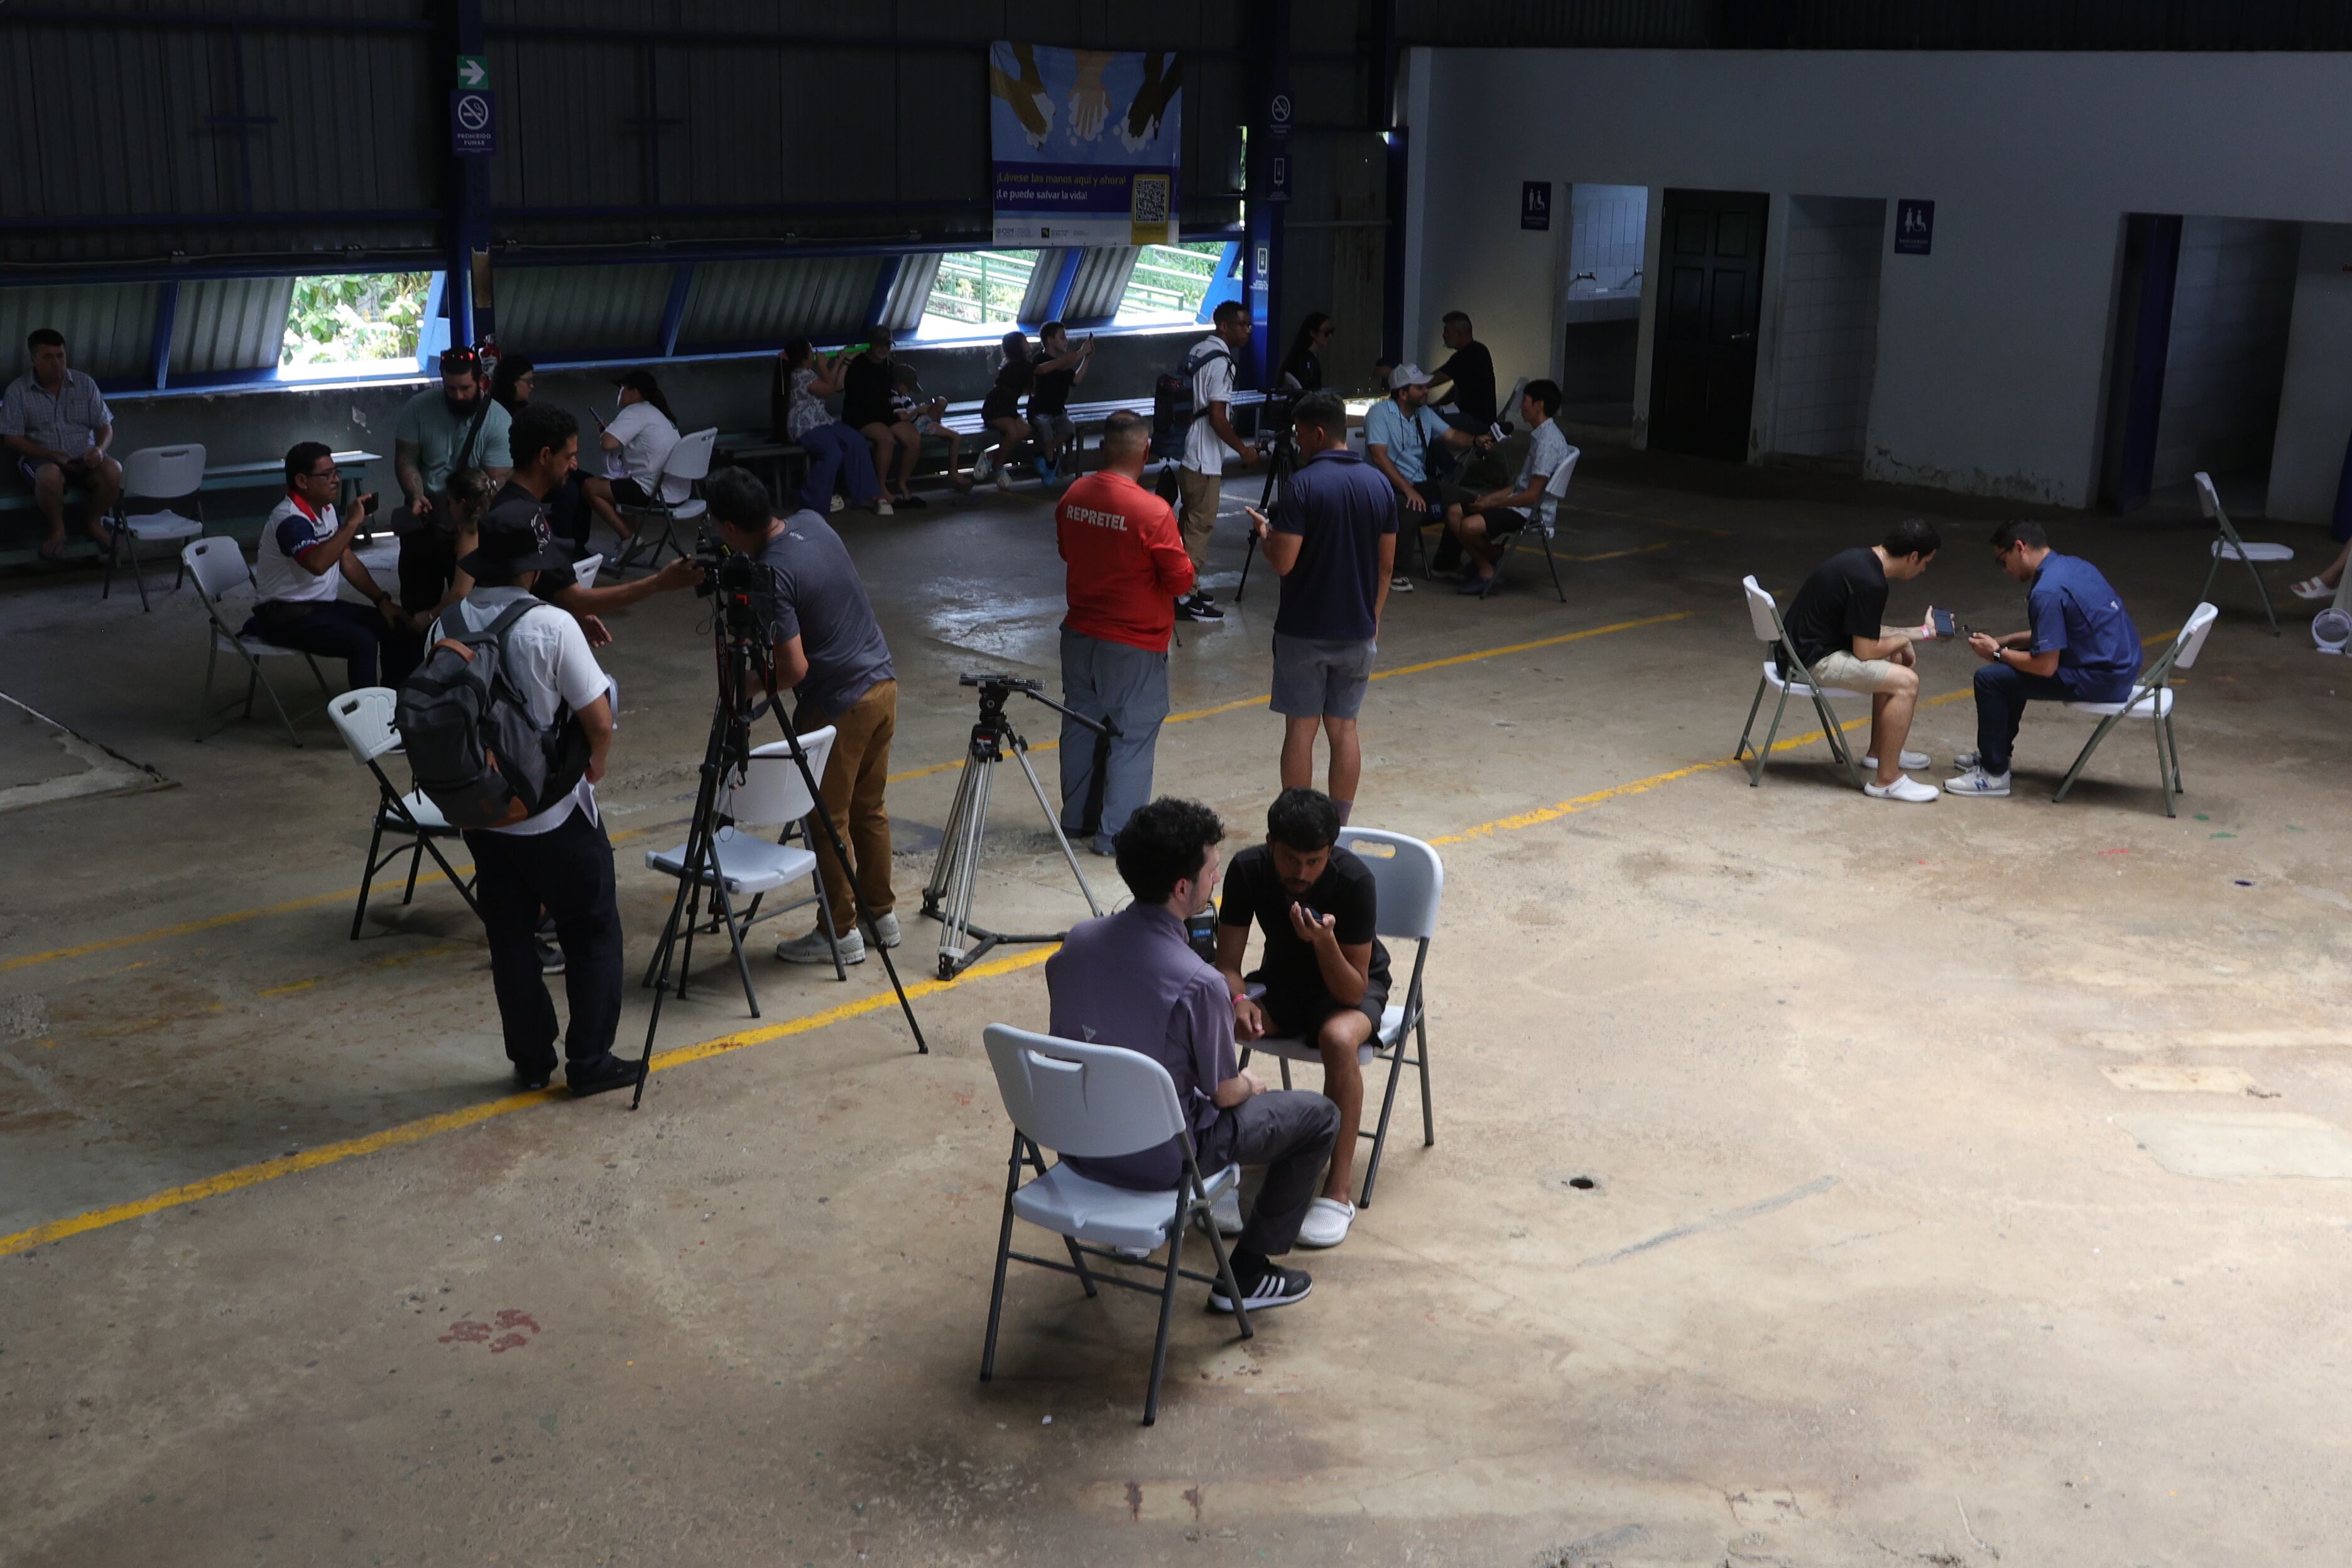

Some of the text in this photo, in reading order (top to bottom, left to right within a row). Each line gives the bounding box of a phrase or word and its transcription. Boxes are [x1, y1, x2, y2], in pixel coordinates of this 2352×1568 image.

[1032, 172, 1043, 181] las
[1092, 175, 1099, 187] y
[1099, 175, 1126, 185] ahora!
[996, 188, 1087, 200] ¡Le puede salvar la vida!
[1066, 504, 1128, 532] REPRETEL
